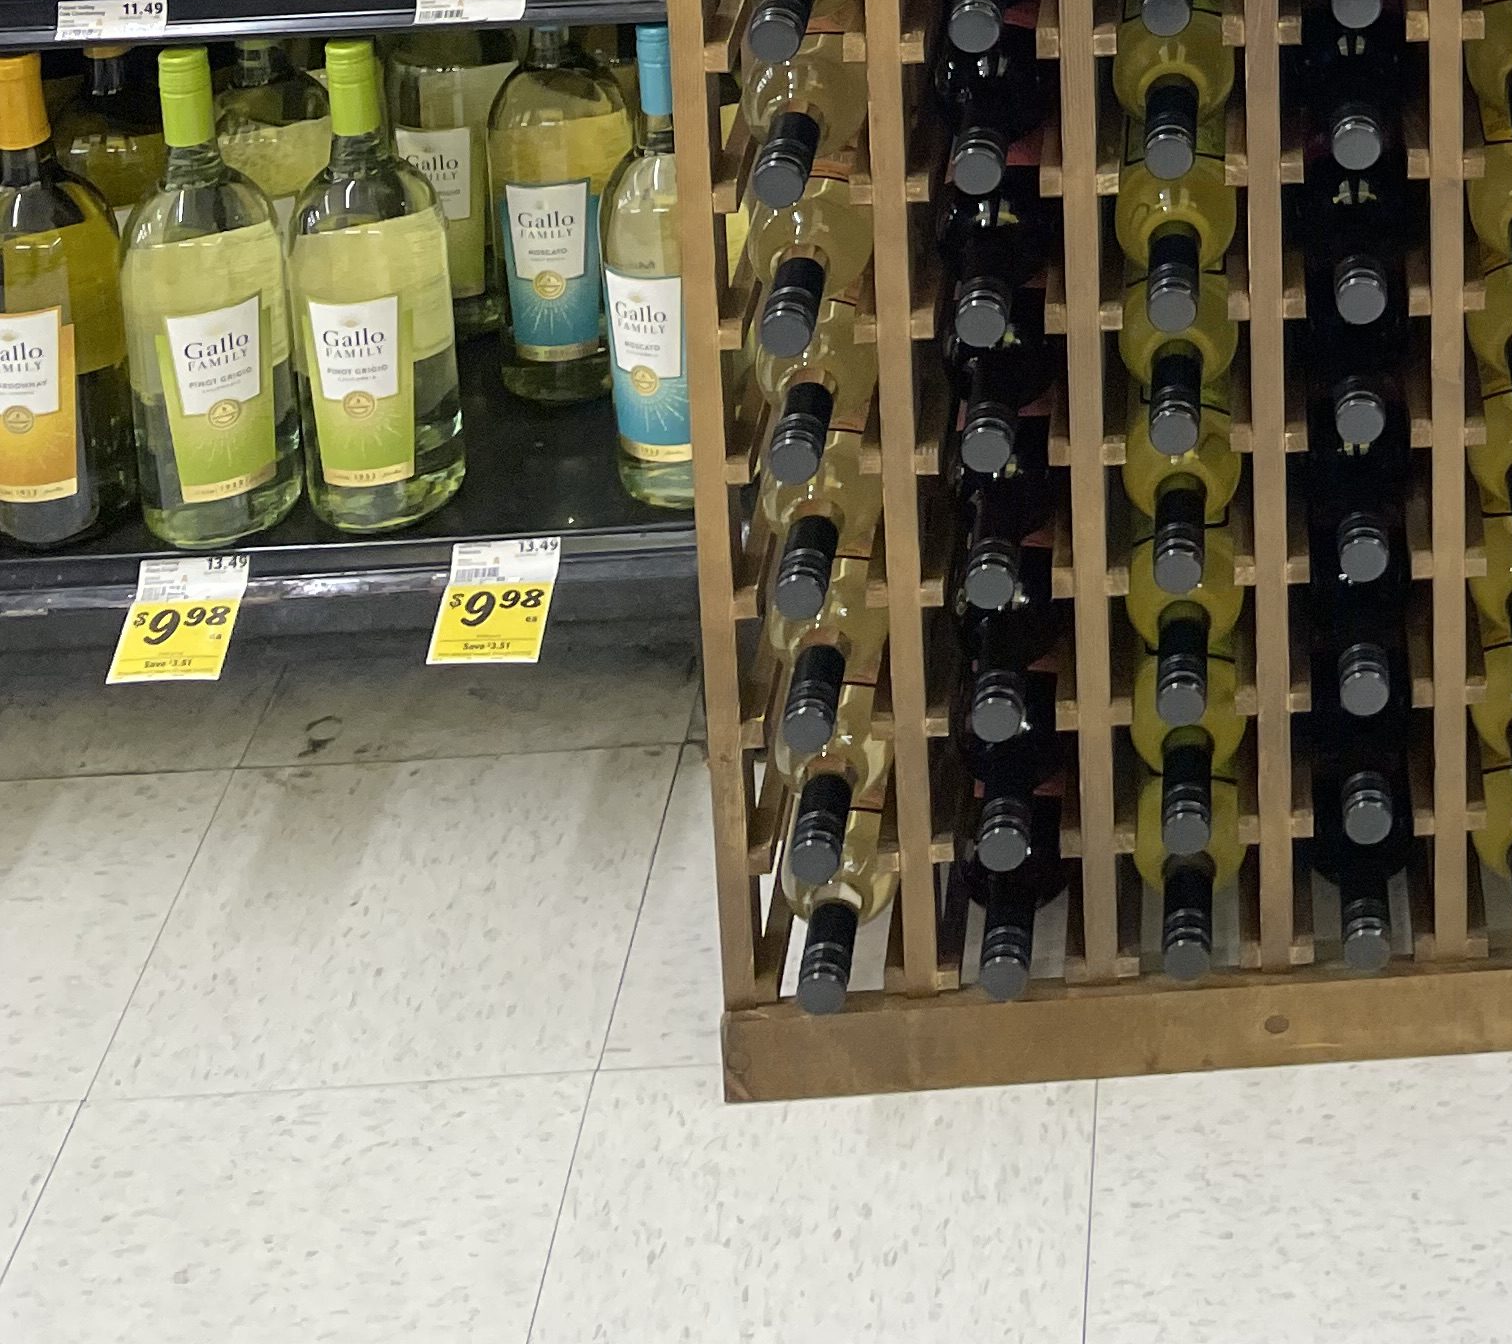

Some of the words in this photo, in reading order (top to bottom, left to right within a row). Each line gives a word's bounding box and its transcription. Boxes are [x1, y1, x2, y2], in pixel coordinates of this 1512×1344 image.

[123, 2, 163, 15] 11.49
[518, 211, 575, 229] Gallo
[519, 227, 573, 240] FAMILY
[615, 300, 668, 323] Gallo
[617, 320, 665, 335] FAMILY
[323, 327, 386, 348] Gallo
[184, 332, 250, 360] Gallo
[326, 344, 385, 359] FAMILY
[188, 348, 249, 372] FAMILY
[189, 377, 217, 389] PINOT
[219, 366, 253, 382] GRIGIO
[327, 367, 352, 375] PINOT
[519, 538, 558, 552] 13.49
[207, 555, 248, 570] 13.49
